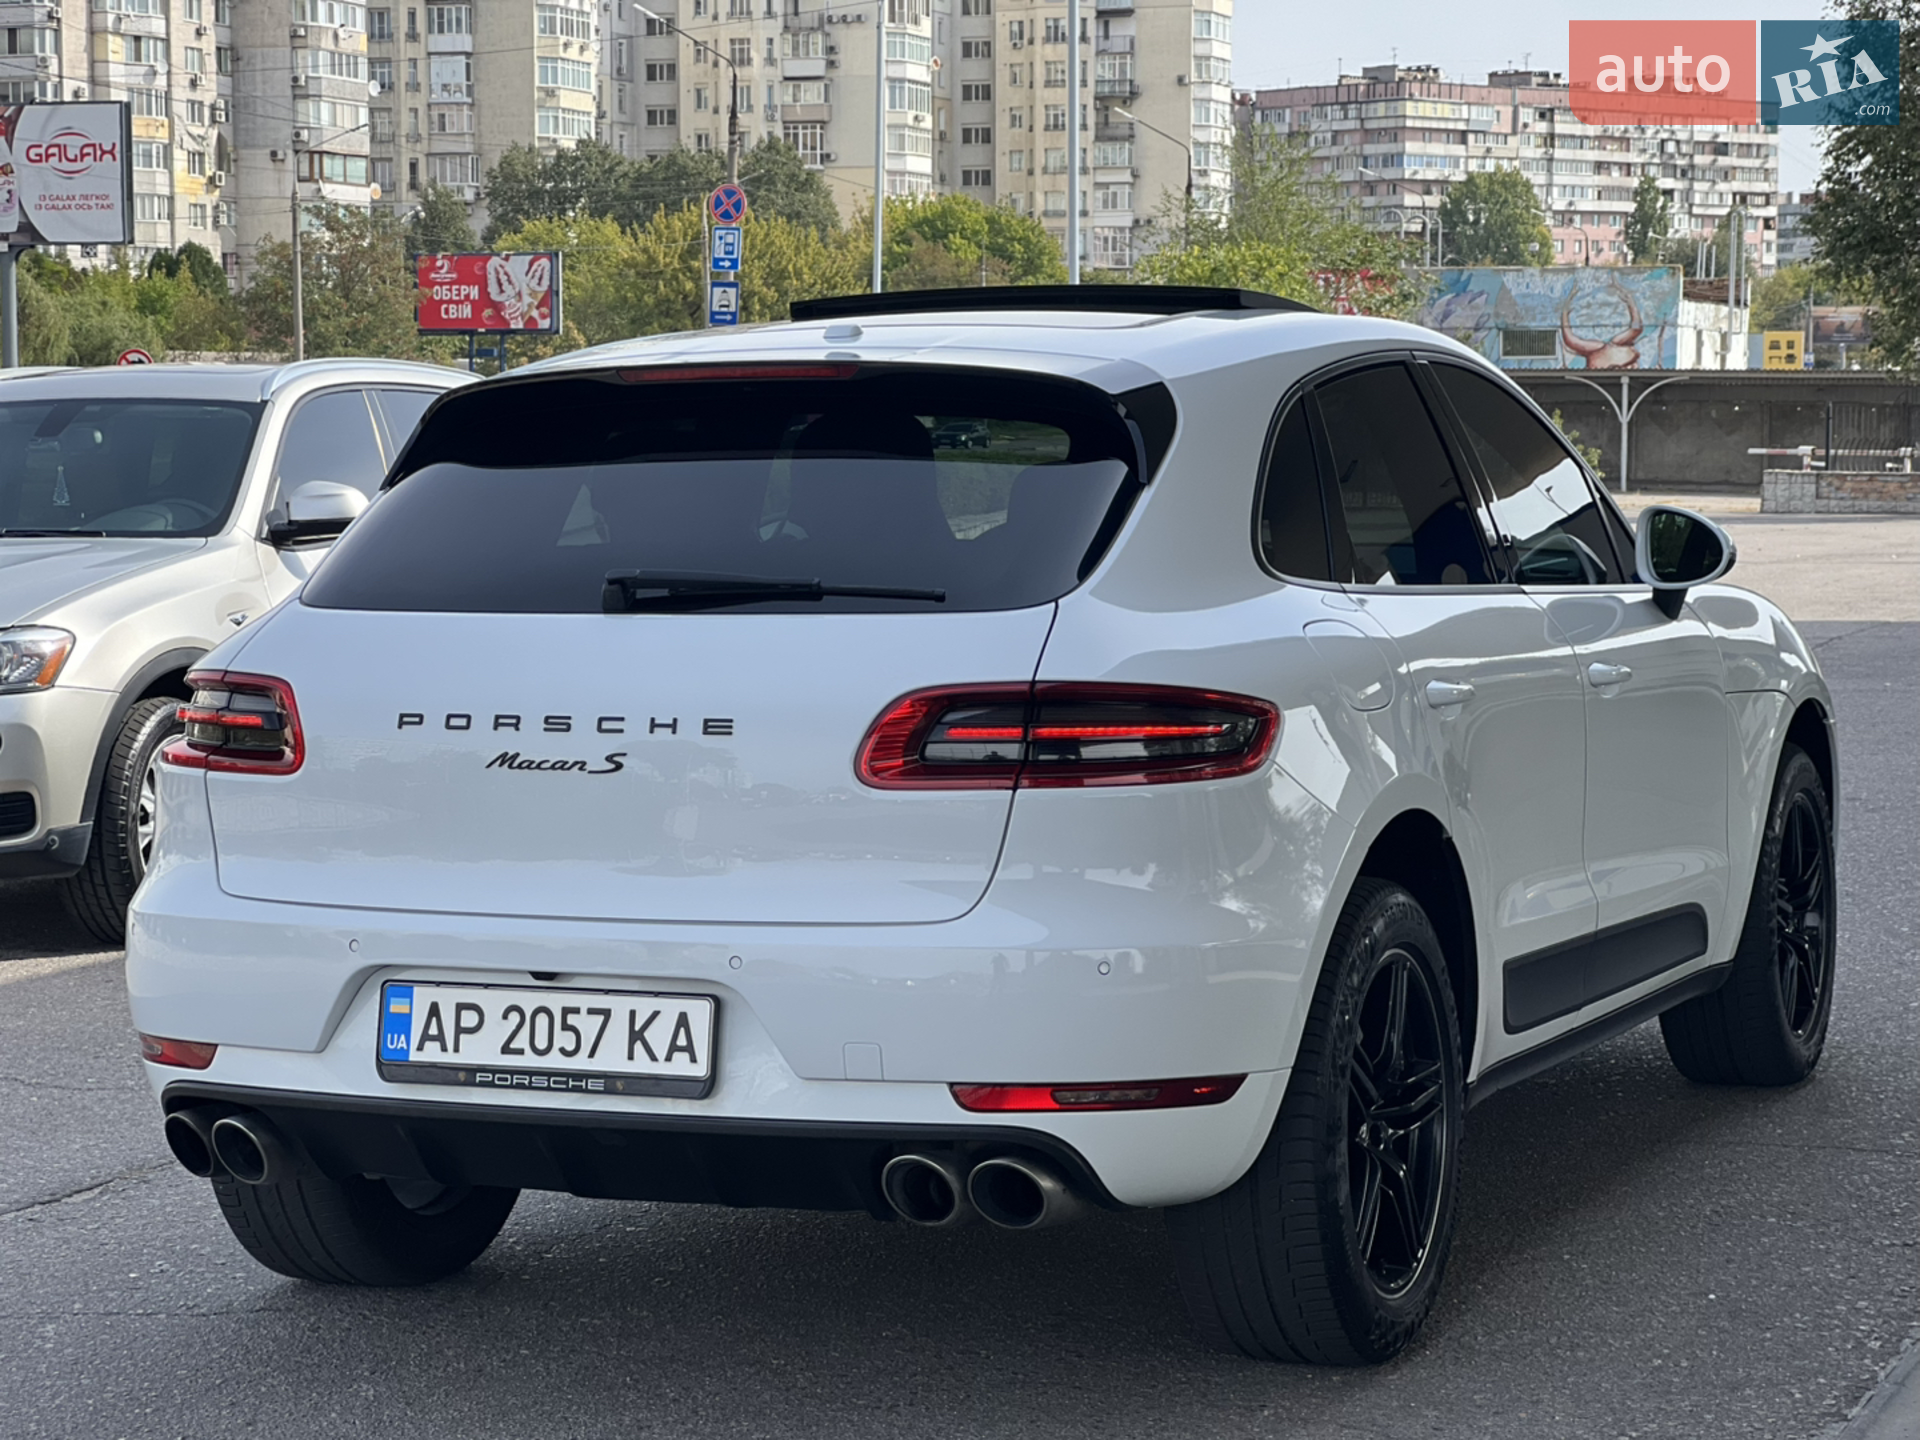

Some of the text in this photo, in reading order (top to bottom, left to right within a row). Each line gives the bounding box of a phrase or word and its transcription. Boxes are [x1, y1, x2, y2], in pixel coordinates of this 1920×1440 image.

[26, 142, 117, 163] GALAX
[44, 203, 73, 211] GALAX
[48, 194, 77, 202] GALAX
[432, 285, 479, 300] ОБЕРИ
[441, 302, 472, 319] СВІЙ
[397, 712, 734, 736] PORSCHE
[485, 751, 628, 774] Macan S
[415, 1000, 698, 1064] AP 2057 KA
[387, 1033, 407, 1050] UA
[475, 1072, 605, 1091] PORSCHE
